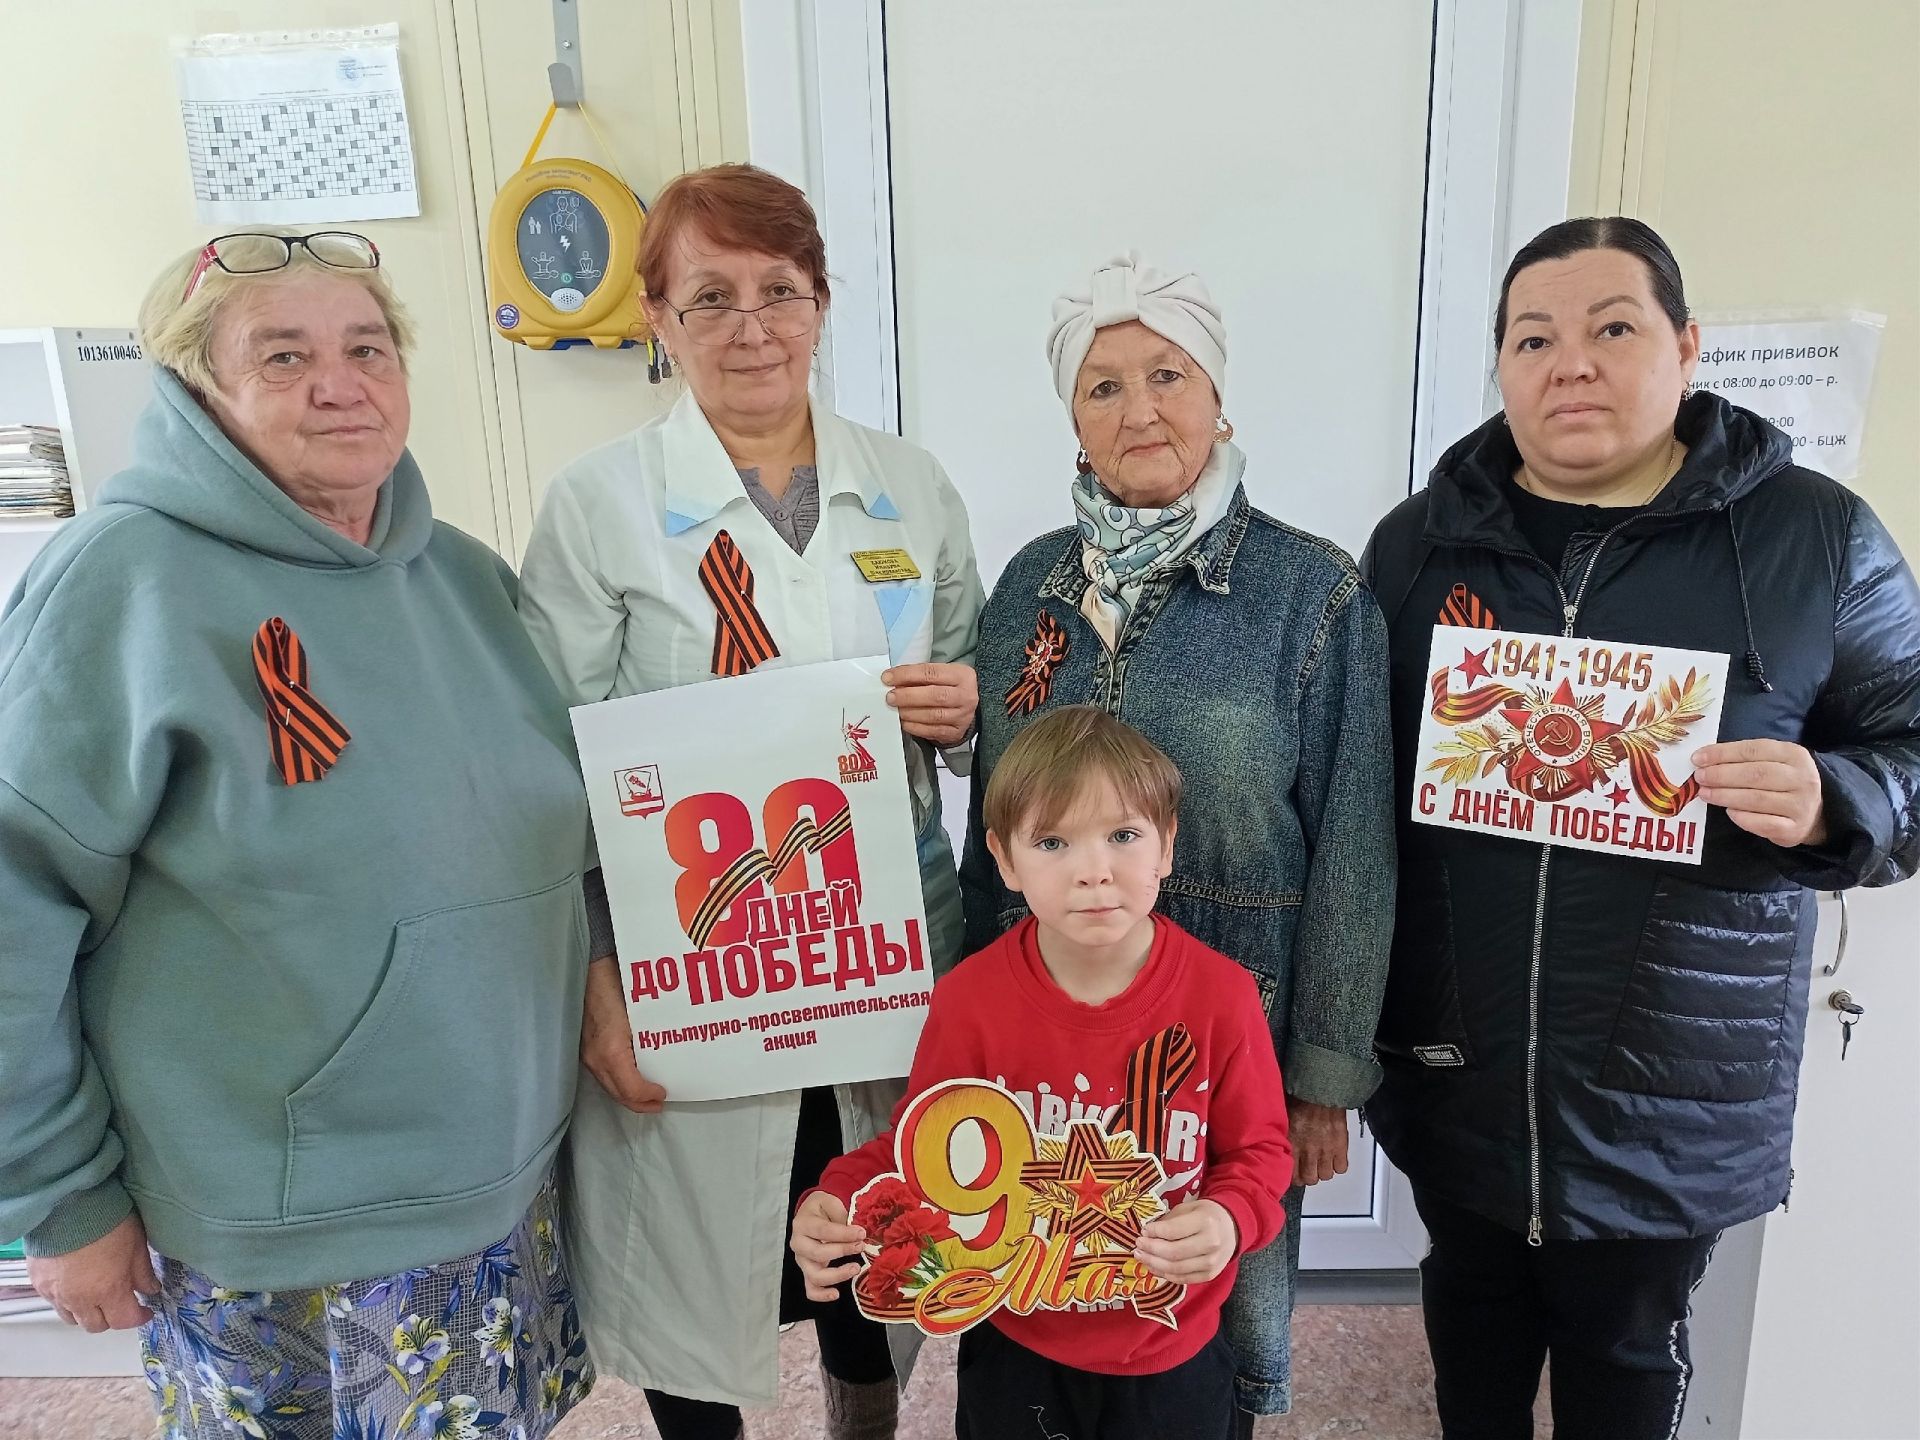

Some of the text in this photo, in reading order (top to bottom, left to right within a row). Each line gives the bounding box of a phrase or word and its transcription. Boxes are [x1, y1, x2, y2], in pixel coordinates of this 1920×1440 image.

[78, 345, 142, 361] 10136100463
[1751, 346, 1840, 363] прививок
[1713, 381, 1719, 389] с
[1723, 377, 1757, 389] 08:00
[1758, 378, 1775, 388] до
[1778, 374, 1813, 386] 09:00
[1763, 416, 1795, 427] 9:00
[1817, 435, 1847, 447] БЦЖ
[1490, 638, 1653, 692] 1941-1945
[837, 753, 859, 772] 80
[840, 771, 878, 784] ПОБЕДА!
[1419, 782, 1697, 854] С ДНЁМ ПОБЕДЫ!
[664, 777, 861, 945] 80
[747, 880, 860, 948] ДНЕЙ
[630, 918, 925, 1006] ДО ПОБЕДЫ
[638, 989, 930, 1051] Культурно-просветительская
[763, 1030, 818, 1053] акция
[901, 1083, 1037, 1272] 9
[914, 1232, 1158, 1337] Мая
